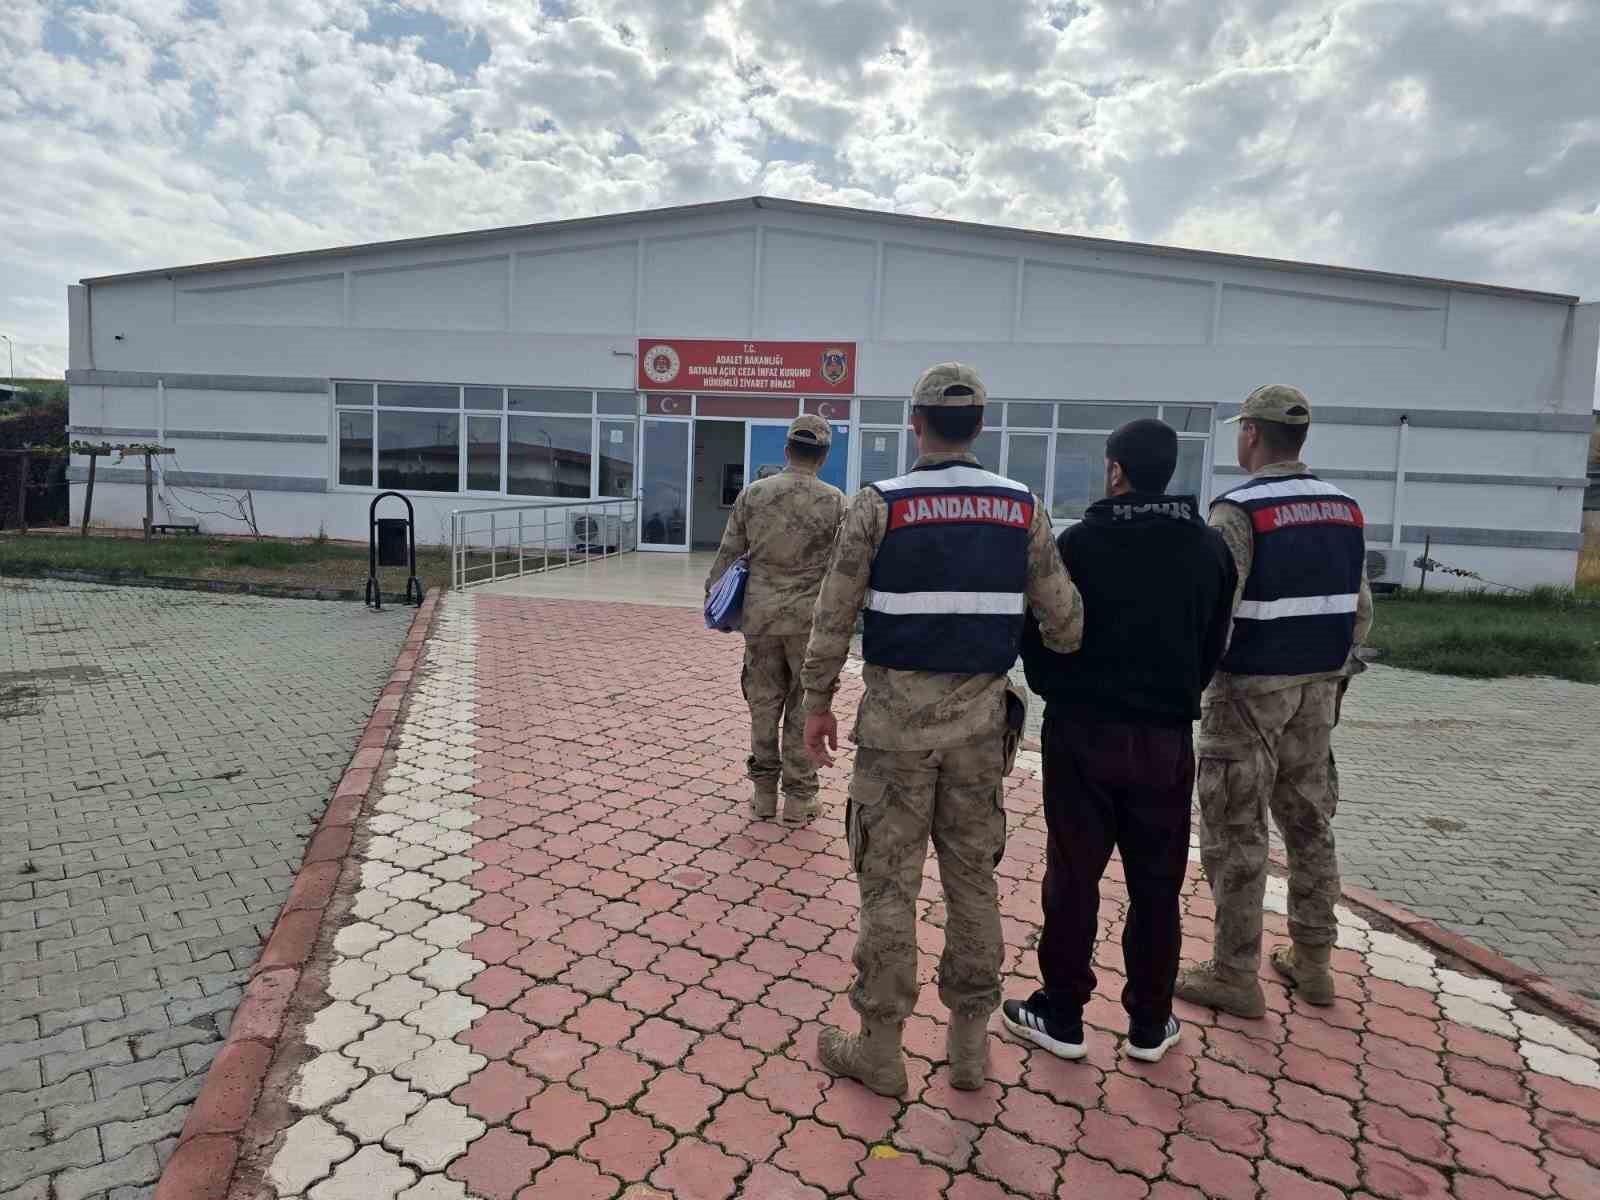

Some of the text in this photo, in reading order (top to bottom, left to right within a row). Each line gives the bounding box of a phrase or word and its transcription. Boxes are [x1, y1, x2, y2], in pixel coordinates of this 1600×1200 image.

[716, 355, 743, 365] ADALET
[688, 366, 717, 376] BATMAN
[719, 367, 737, 378] AÇIK
[737, 367, 756, 376] CEZA
[779, 367, 811, 377] KURUMU
[903, 496, 1024, 523] JANDARMA
[1273, 502, 1354, 527] JANDARMA
